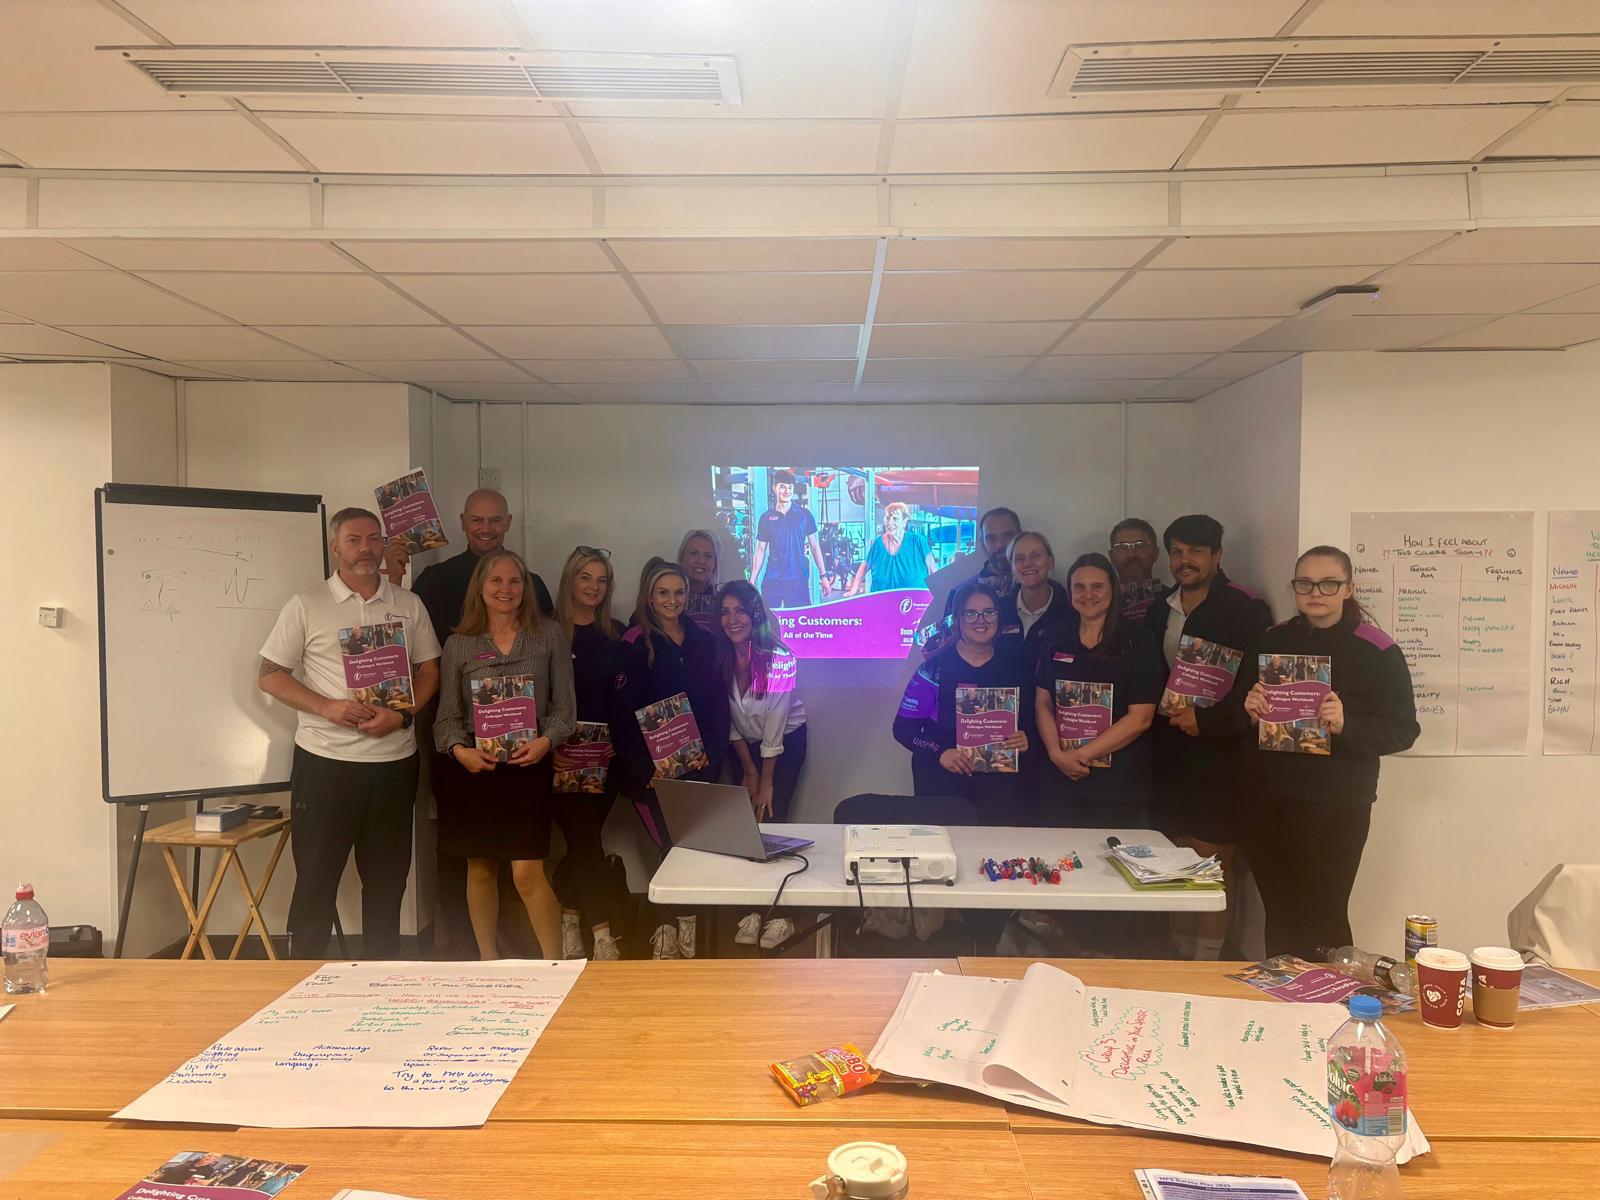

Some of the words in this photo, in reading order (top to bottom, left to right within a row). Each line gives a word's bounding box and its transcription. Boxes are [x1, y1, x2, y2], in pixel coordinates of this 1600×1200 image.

[1428, 537, 1435, 547] I
[798, 616, 863, 626] Customers:
[349, 656, 373, 665] Delighting
[478, 707, 502, 715] Delighting
[20, 929, 46, 941] evian
[1456, 977, 1468, 1017] COSTA
[313, 1044, 371, 1053] Acknowledge
[392, 1069, 414, 1082] Try
[136, 1187, 186, 1200] Delighting
